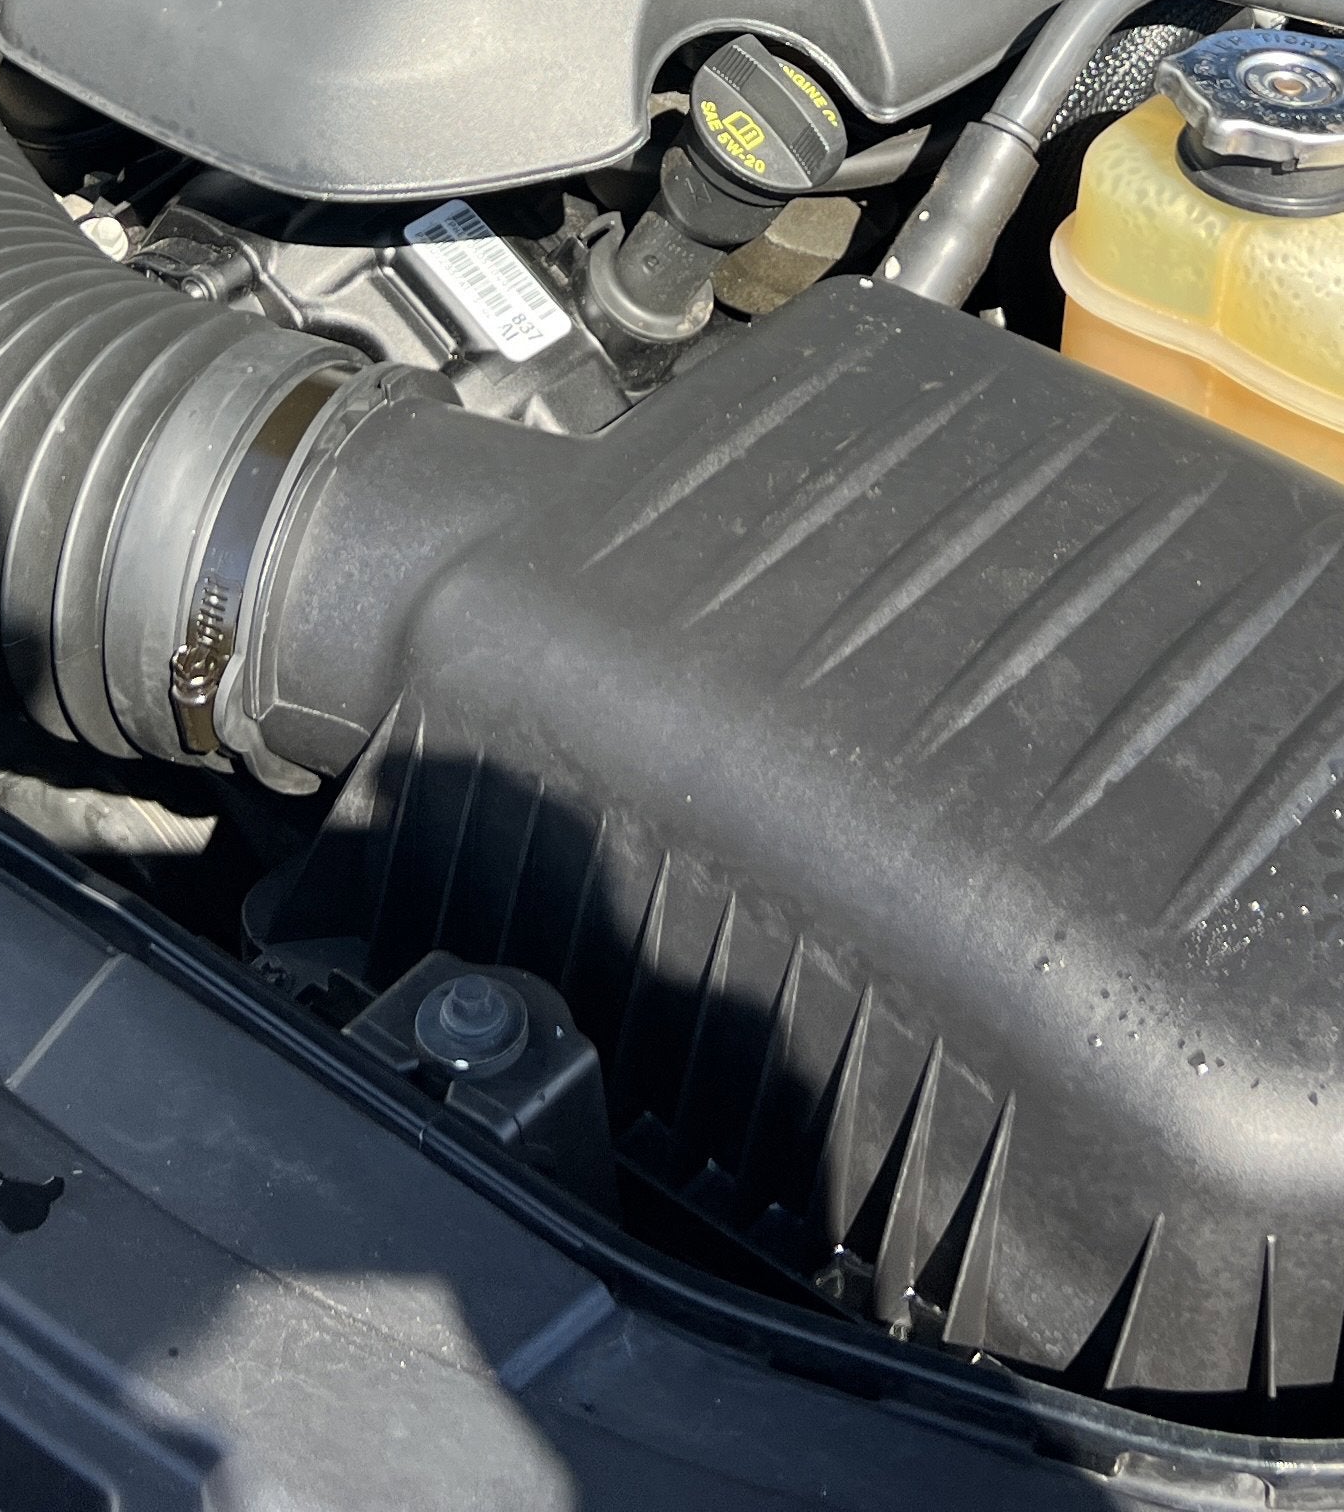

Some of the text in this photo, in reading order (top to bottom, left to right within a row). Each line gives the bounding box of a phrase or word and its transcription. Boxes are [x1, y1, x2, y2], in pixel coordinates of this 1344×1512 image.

[778, 62, 828, 109] NGINE
[700, 100, 767, 175] SAE 5W-20
[511, 312, 545, 341] 837
